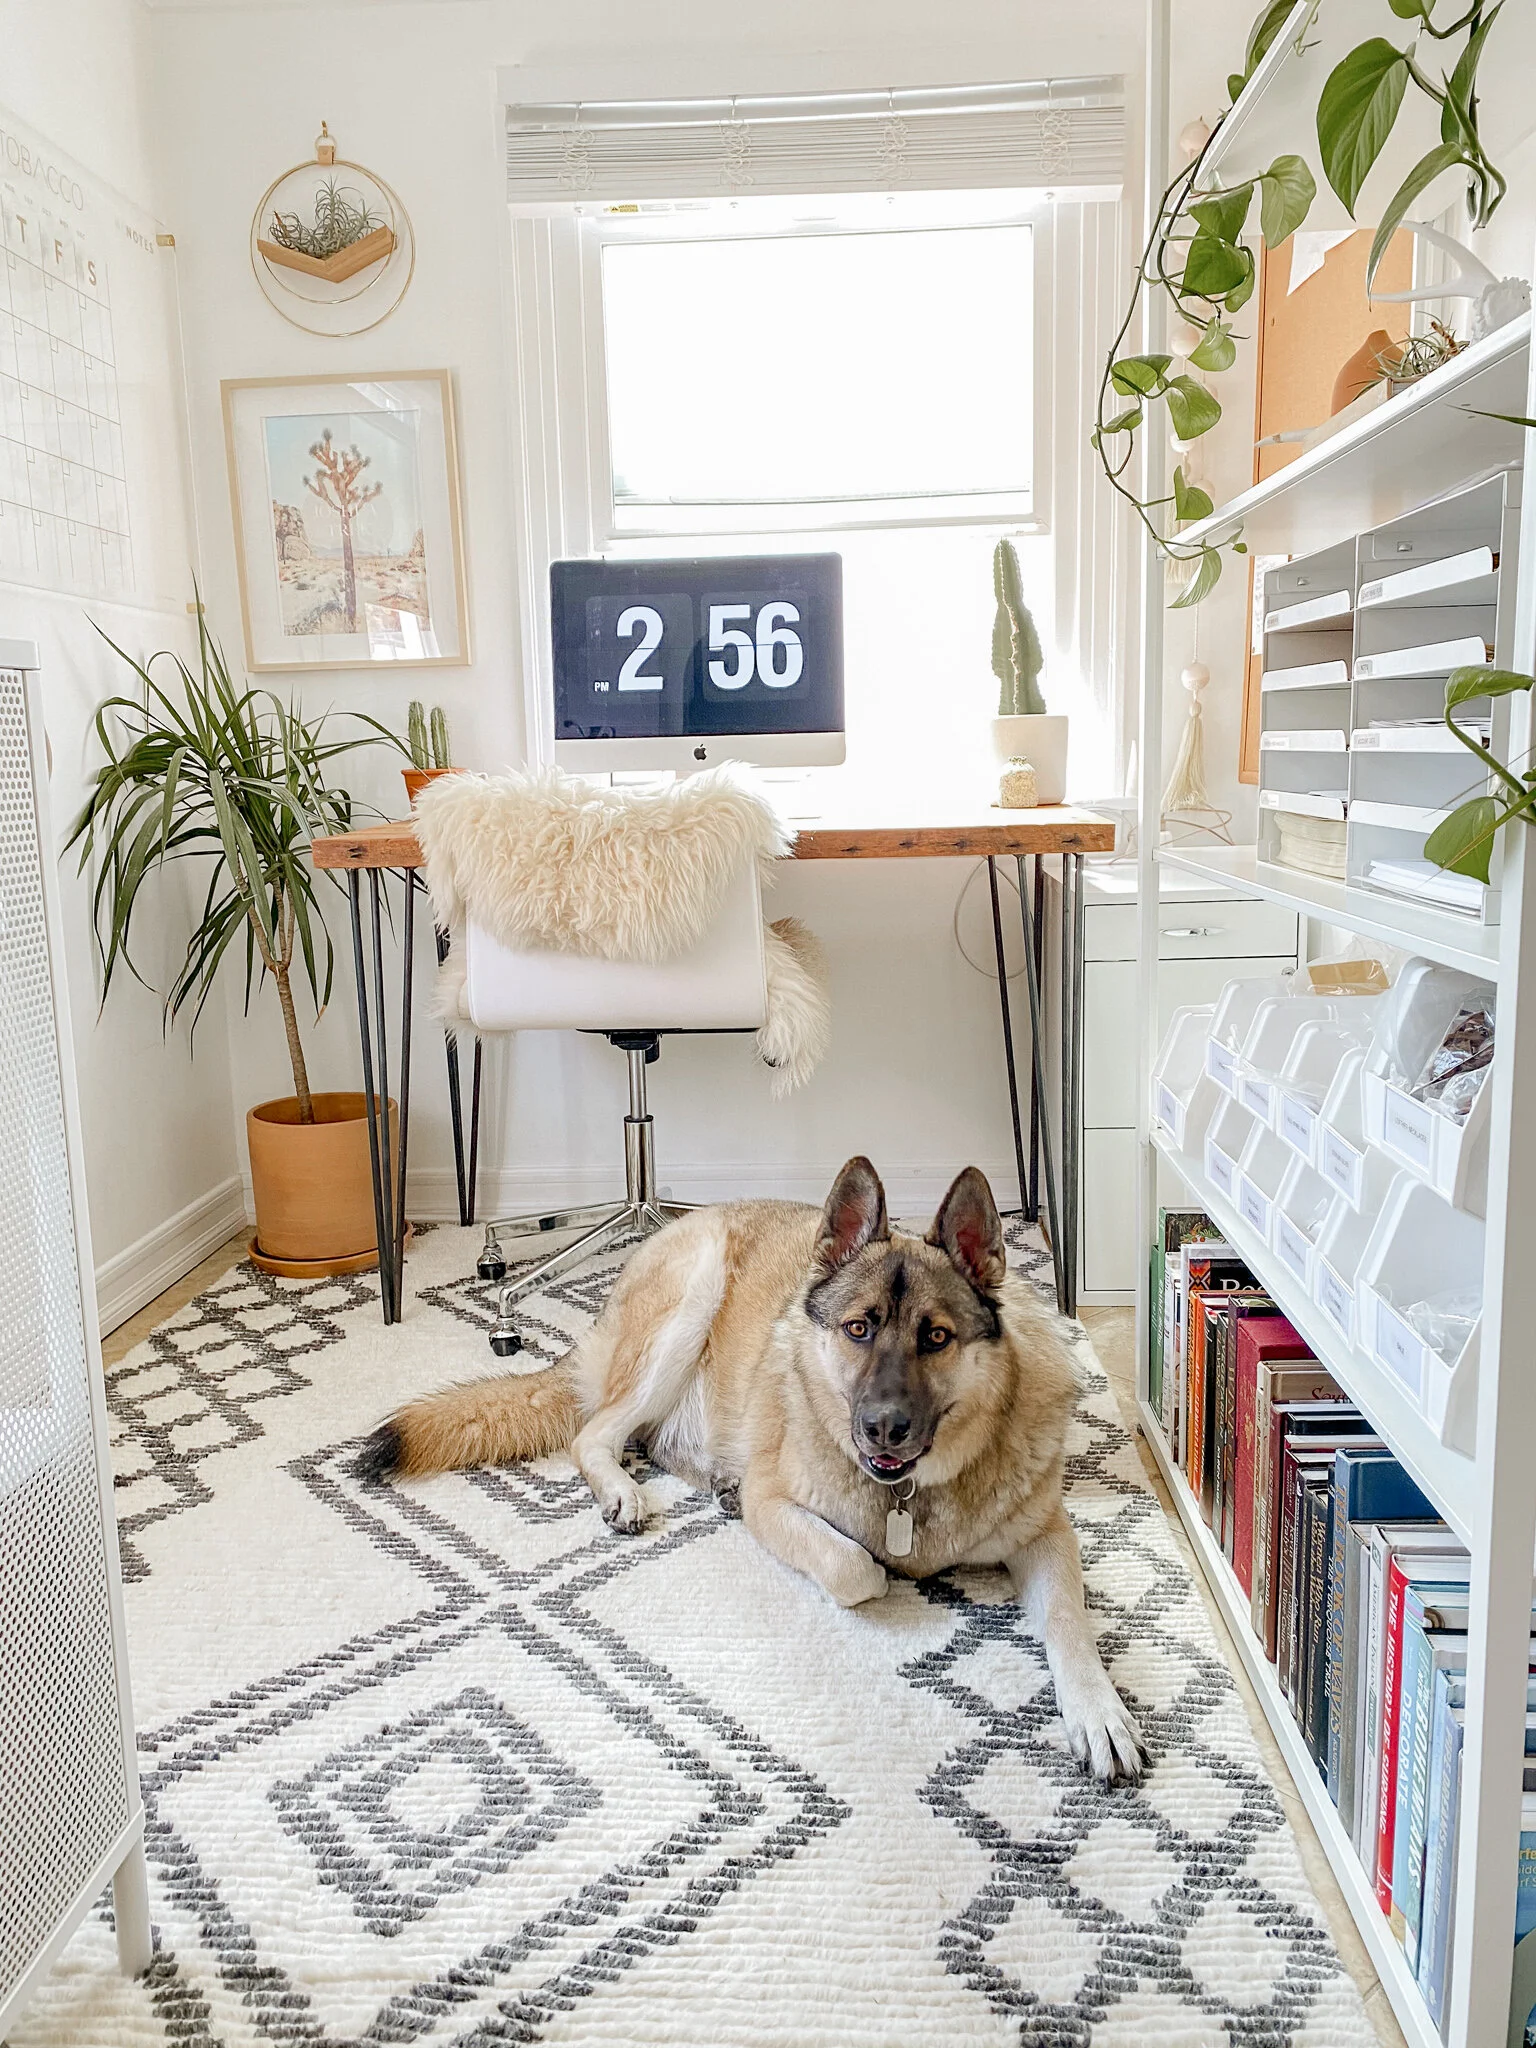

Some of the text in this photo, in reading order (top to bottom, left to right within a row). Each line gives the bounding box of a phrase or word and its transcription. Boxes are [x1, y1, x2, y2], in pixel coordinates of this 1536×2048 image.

[54, 239, 63, 264] F
[87, 260, 97, 286] S
[126, 226, 154, 255] NOTES
[594, 681, 609, 692] PM
[616, 601, 804, 692] 2 56
[1313, 1521, 1327, 1644] Women Who Run
[1324, 1556, 1335, 1698] THE TURQUOISE TRAIL
[1330, 1484, 1347, 1738] THE BOOK OF WAVES
[1372, 1579, 1380, 1642] AMERICAN
[1370, 1644, 1378, 1690] INDIAN
[1380, 1591, 1399, 1834] THE HISTORY OF SURFING
[1399, 1691, 1412, 1810] DECORATE
[1408, 1700, 1429, 1889] BOHEMIANS
[1439, 1726, 1453, 1848] PIPE DREAMS
